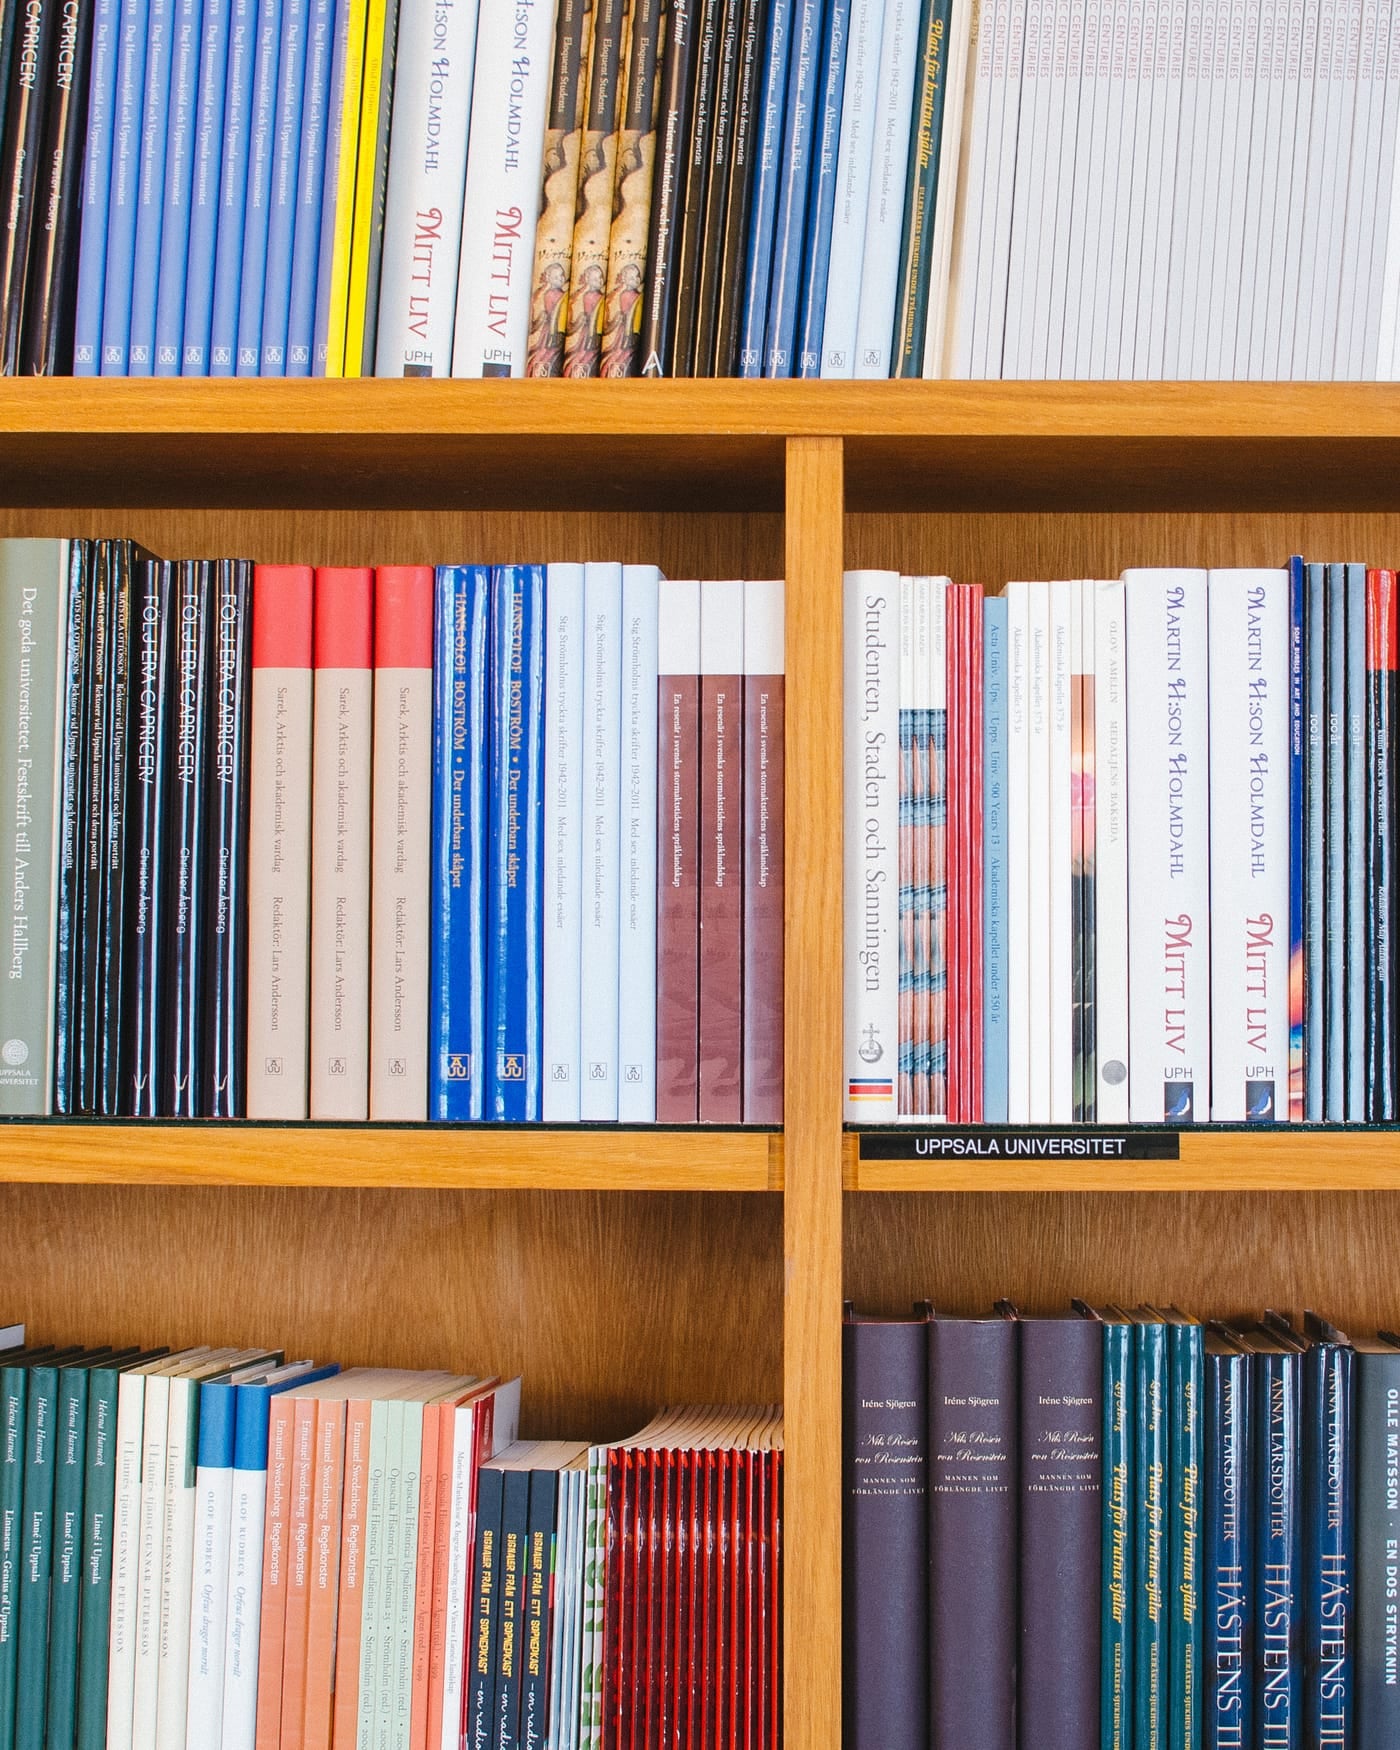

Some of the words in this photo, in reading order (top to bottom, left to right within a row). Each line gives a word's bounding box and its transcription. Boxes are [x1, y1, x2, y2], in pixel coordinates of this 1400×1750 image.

[313, 24, 326, 40] Dag
[672, 12, 689, 45] Linné
[927, 19, 944, 58] Plats
[559, 36, 572, 74] Eloquent
[1009, 16, 1023, 79] CENTURIES
[309, 42, 326, 103] Hammarskjöld
[826, 58, 840, 95] Wiman
[924, 55, 941, 80] för
[310, 104, 322, 121] och
[558, 76, 569, 113] Students
[922, 82, 938, 128] brutna
[424, 58, 450, 174] HOLMDAHL
[666, 110, 678, 150] Mariette
[824, 105, 836, 150] Abraham
[305, 123, 320, 157] Uppsala
[918, 130, 935, 168] själar
[50, 149, 63, 190] Christer
[304, 160, 316, 204] universitet
[660, 152, 674, 205] Manktelow
[821, 152, 832, 176] Bäck
[45, 194, 62, 230] Åsberg
[659, 207, 670, 225] och
[412, 208, 443, 287] MITT
[655, 228, 669, 274] Petronella
[651, 276, 665, 321] Kettunen
[408, 296, 428, 339] LIV
[405, 350, 433, 363] UPH
[22, 588, 37, 614] Det
[118, 592, 126, 612] MATS
[19, 619, 36, 653] goda
[142, 596, 161, 644] FÖLJ
[454, 593, 466, 674] HANS-OLOF
[630, 618, 640, 634] Stig
[990, 624, 1000, 646] Acta
[1109, 621, 1118, 654] OLOV
[1167, 587, 1184, 670] MARTIN
[116, 632, 125, 674] OTTOSSON
[140, 650, 157, 683] ERA
[630, 636, 640, 690] Strömholms
[863, 595, 886, 722] Studenten,
[990, 651, 1000, 678] Univ.
[717, 694, 726, 704] En
[988, 682, 1000, 705] Ups.
[1109, 658, 1118, 703] AMELIN
[18, 658, 34, 752] universitetet.
[116, 684, 124, 716] Rektorer
[275, 688, 288, 719] Sarek,
[454, 680, 467, 750] BOSTRÖM
[630, 694, 640, 724] tryckta
[114, 718, 124, 730] vid
[717, 706, 725, 733] resenär
[988, 718, 1000, 746] Upps.
[112, 732, 124, 760] Uppsala
[276, 722, 286, 755] Arktis
[630, 728, 640, 760] skrifter
[717, 740, 725, 768] svenska
[1108, 720, 1118, 786] MEDALJENS
[112, 763, 121, 801] universitet
[276, 758, 286, 776] och
[454, 770, 464, 790] Det
[864, 731, 886, 808] Staden
[990, 751, 1000, 778] Univ.
[15, 759, 33, 827] Festskrift
[274, 780, 286, 835] akademisk
[716, 771, 725, 831] stormaktstidens
[991, 782, 1000, 798] 500
[112, 803, 120, 817] och
[112, 819, 120, 838] deras
[452, 794, 464, 850] underbara
[630, 818, 639, 838] Med
[990, 802, 1000, 831] Years
[1110, 792, 1118, 842] BAKSIDA
[1169, 753, 1187, 878] HOLMDAHL
[15, 832, 31, 852] till
[110, 840, 120, 869] porträtt
[272, 838, 283, 872] vardag
[865, 818, 886, 859] och
[991, 834, 1000, 845] 13
[450, 853, 463, 888] skåpet
[715, 834, 726, 887] språklandskap
[14, 856, 30, 910] Anders
[630, 858, 639, 901] inledande
[990, 857, 1000, 917] Akademiska
[272, 896, 283, 947] Redaktör:
[630, 904, 638, 930] essäer
[859, 869, 887, 992] Sanningen
[9, 915, 28, 978] Hallberg
[988, 920, 1000, 960] kapellet
[1165, 914, 1192, 998] MITT
[272, 950, 282, 972] Lars
[990, 962, 1000, 990] under
[271, 975, 282, 1030] Andersson
[990, 994, 1000, 1012] 350
[990, 1014, 1000, 1024] år
[1165, 1008, 1186, 1054] LIV
[1165, 1067, 1193, 1078] UPH
[916, 1138, 1000, 1154] UPPSALA
[1005, 1138, 1126, 1154] UNIVERSITET
[96, 1400, 108, 1429] Helena
[944, 1396, 967, 1406] Iréne
[968, 1397, 999, 1407] Sjögren
[1272, 1377, 1283, 1424] ANNA
[1387, 1389, 1398, 1426] OLLE
[94, 1432, 106, 1466] Harnesk
[323, 1422, 334, 1462] Emanuel
[938, 1454, 954, 1462] von
[956, 1449, 1006, 1462] Rosenstein
[944, 1431, 967, 1444] Nils
[1272, 1433, 1283, 1538] LARSDOTTER
[1386, 1434, 1398, 1510] MATSSON
[240, 1493, 248, 1520] OLOF
[320, 1464, 334, 1520] Swedenborg
[404, 1472, 416, 1514] Opuscula
[4, 1510, 14, 1551] Linnaeus
[93, 1513, 104, 1540] Linné
[403, 1517, 414, 1558] Historica
[89, 1548, 102, 1584] Uppsala
[118, 1531, 128, 1580] GUNNAR
[238, 1527, 246, 1576] RUDBECK
[318, 1524, 330, 1588] Regelkonsten
[532, 1532, 542, 1569] SIGNALER
[1386, 1539, 1396, 1559] EN
[2, 1561, 11, 1592] Genius
[400, 1562, 412, 1612] Upsaliensia
[531, 1572, 542, 1596] FRÅN
[1386, 1566, 1396, 1598] DOS
[2, 1594, 12, 1604] of
[531, 1599, 540, 1616] ETT
[0, 1606, 10, 1642] Uppsala
[116, 1586, 126, 1653] PETERSSON
[1264, 1564, 1294, 1708] HÄSTENS
[1386, 1604, 1396, 1685] STRYKNIN
[398, 1639, 410, 1690] Strömholm
[397, 1692, 408, 1717] (red.)
